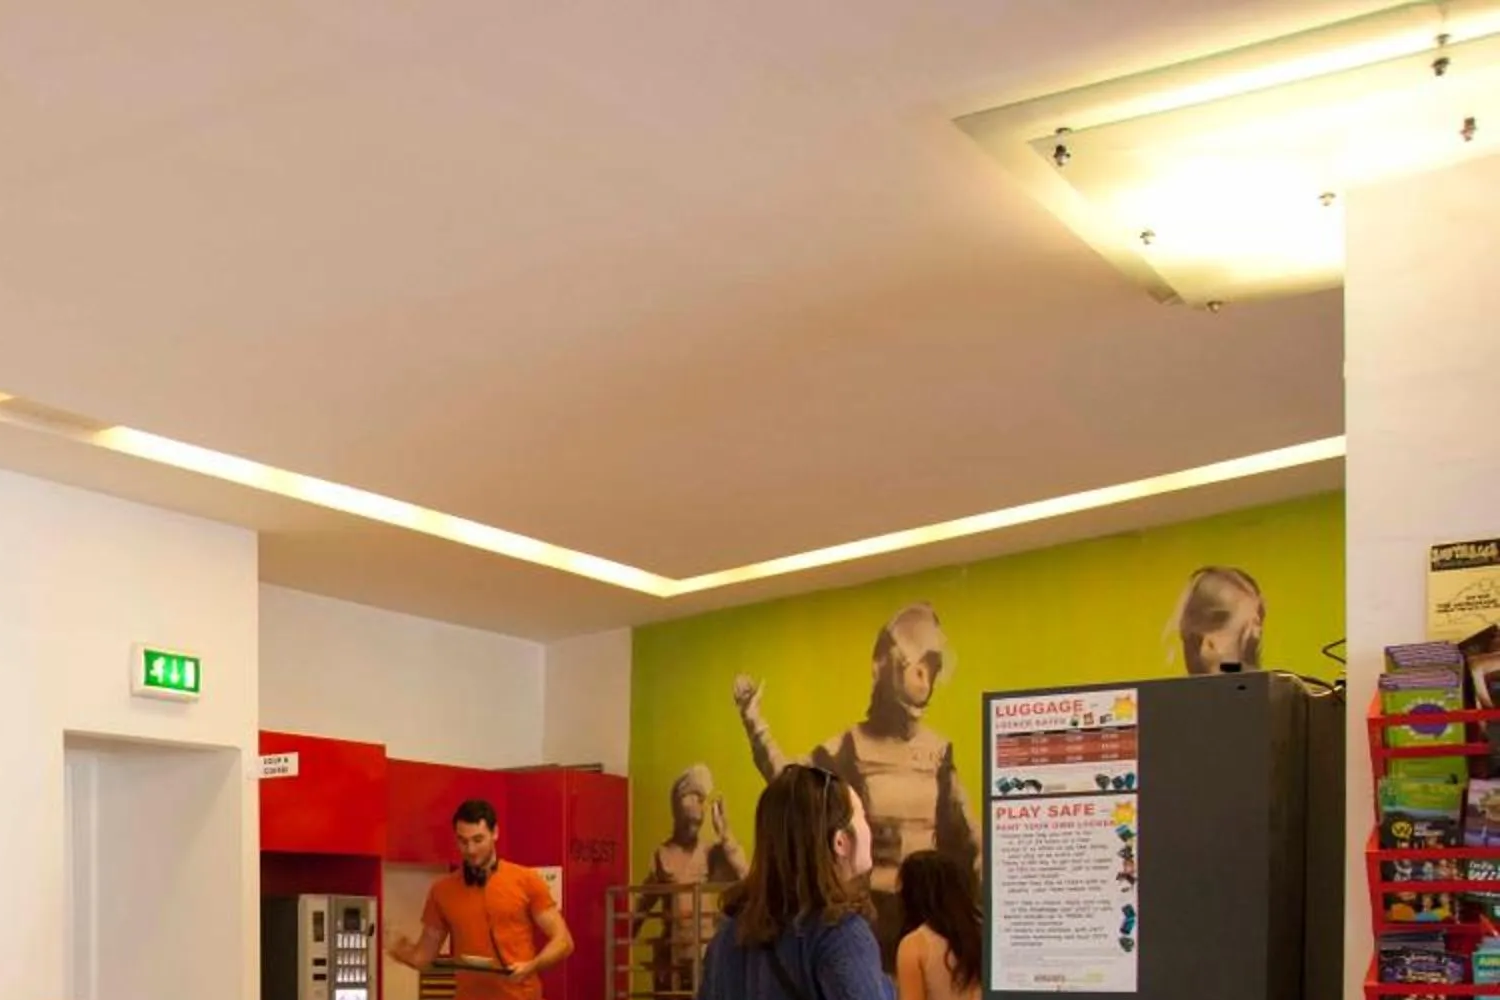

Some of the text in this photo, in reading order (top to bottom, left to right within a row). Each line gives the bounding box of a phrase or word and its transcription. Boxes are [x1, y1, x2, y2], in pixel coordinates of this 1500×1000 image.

[995, 699, 1084, 717] LUGGAGE
[995, 803, 1095, 819] PLAY SAFE
